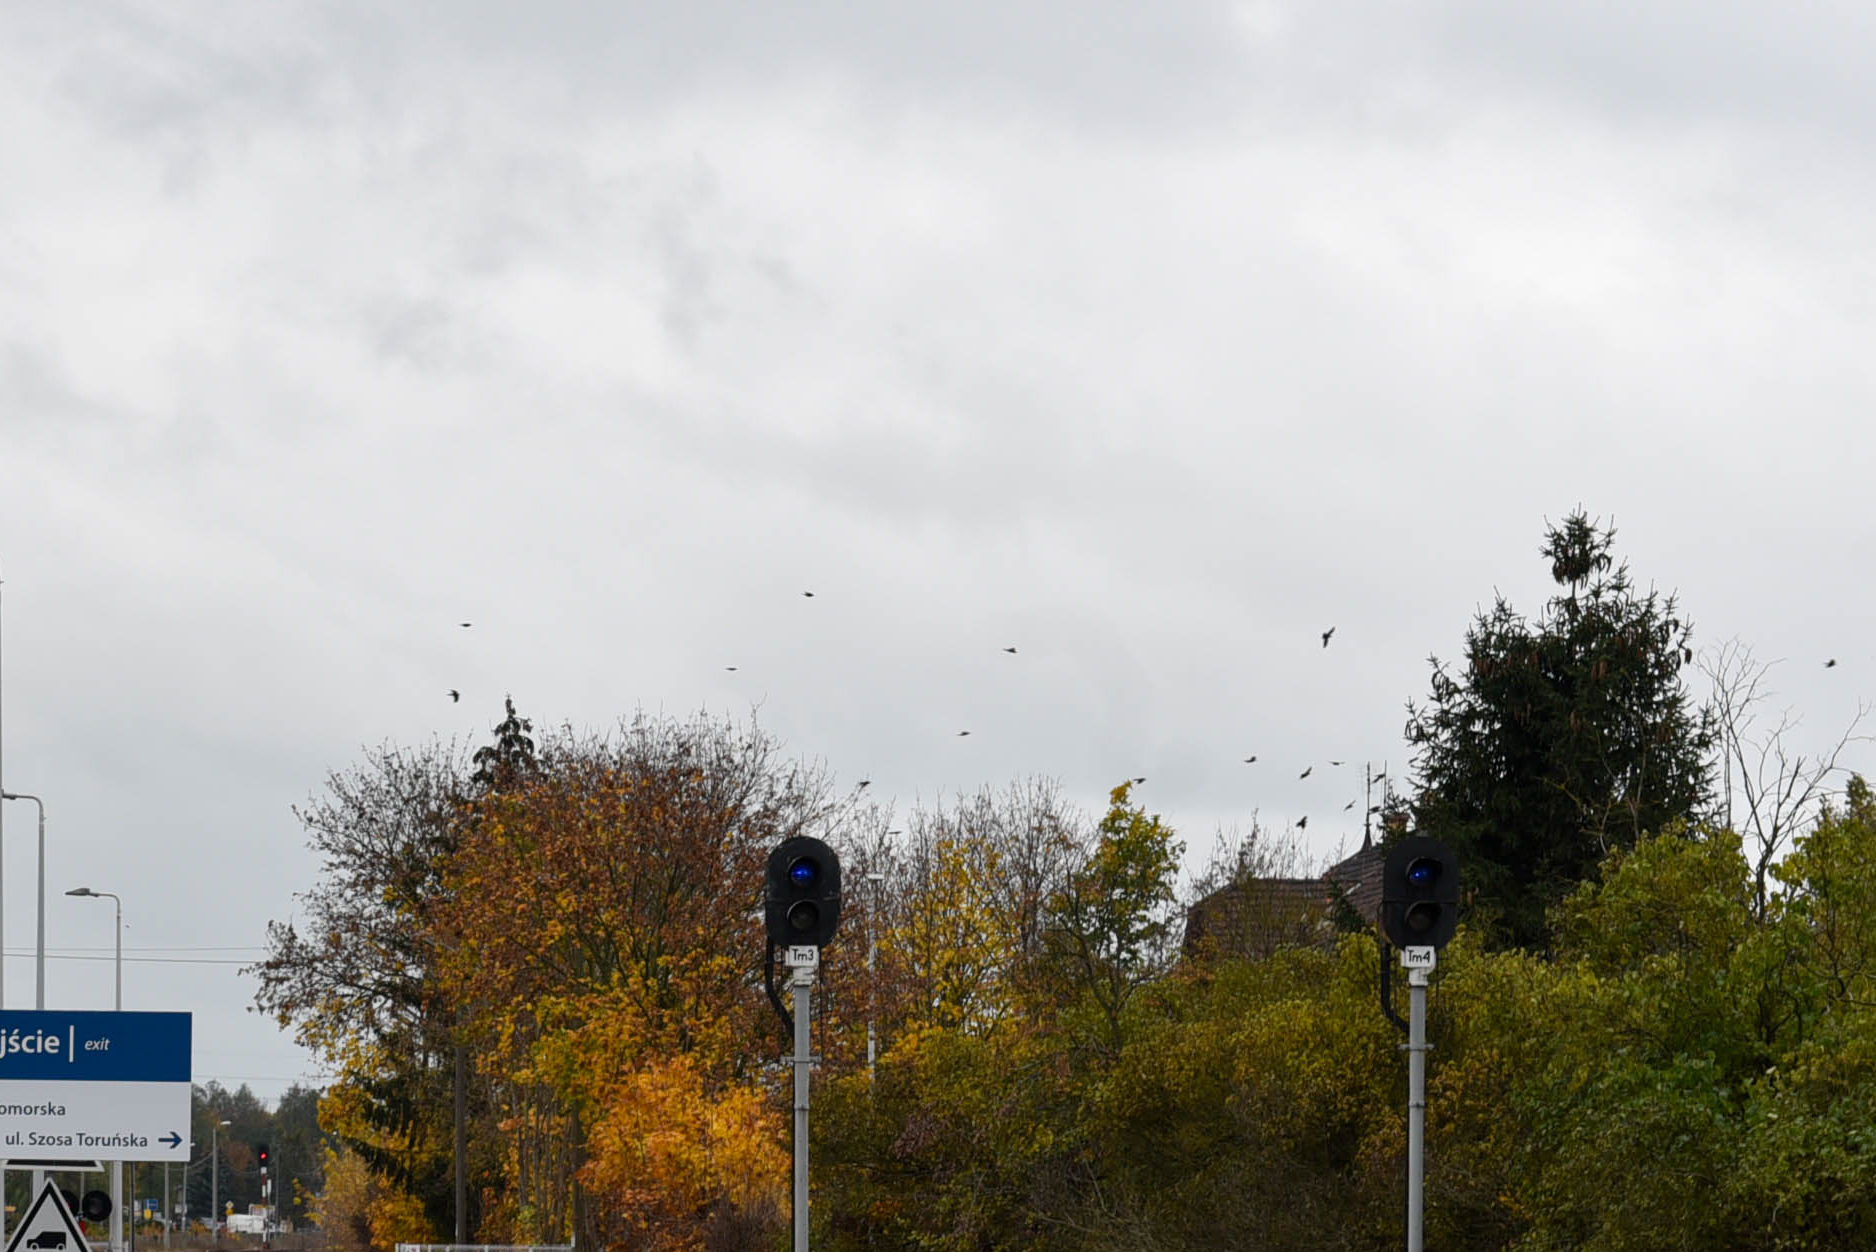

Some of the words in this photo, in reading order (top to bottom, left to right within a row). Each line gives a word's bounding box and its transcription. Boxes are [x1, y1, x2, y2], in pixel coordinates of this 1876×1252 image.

[791, 947, 814, 961] Tm3
[1407, 948, 1431, 963] Tm4
[84, 1037, 110, 1051] exit
[5, 1131, 24, 1146] ul.
[28, 1132, 73, 1147] Szosa
[76, 1131, 148, 1148] Toruńska
